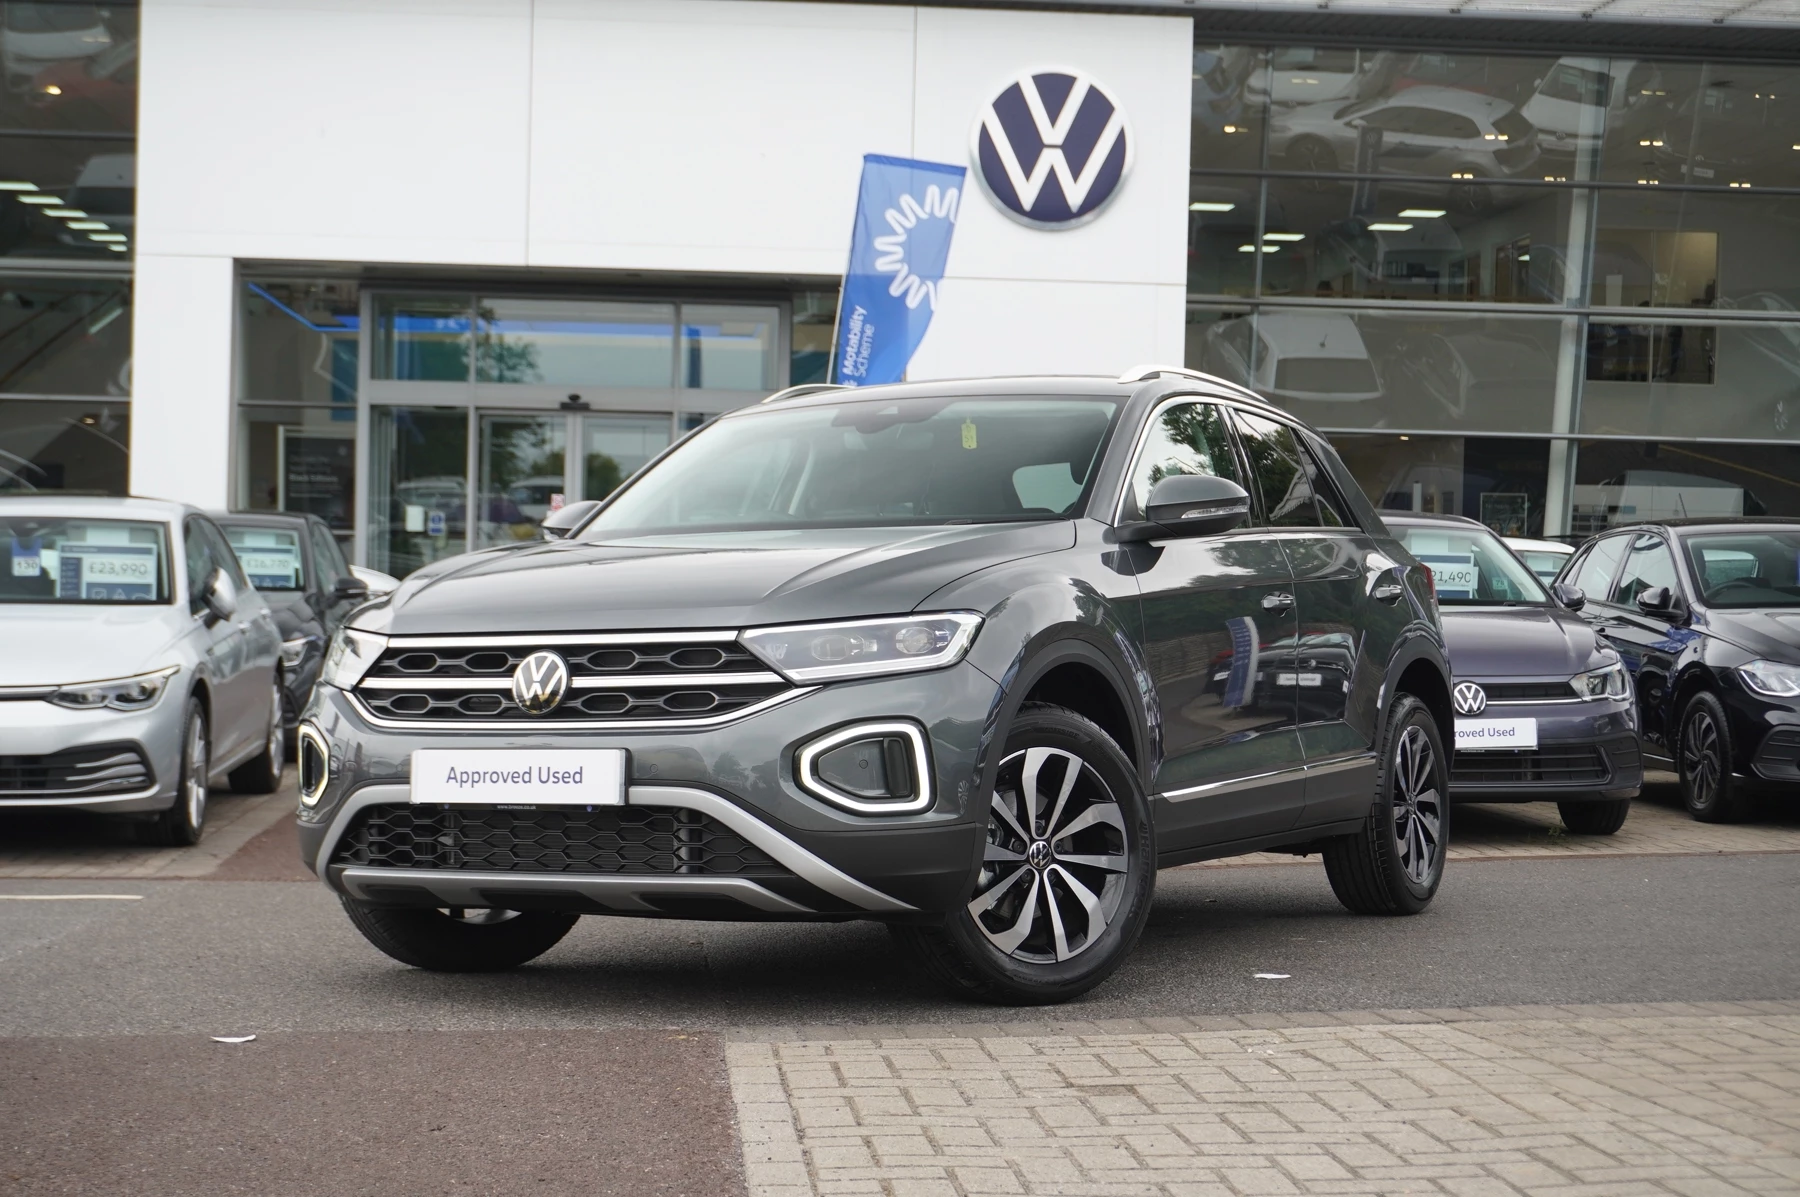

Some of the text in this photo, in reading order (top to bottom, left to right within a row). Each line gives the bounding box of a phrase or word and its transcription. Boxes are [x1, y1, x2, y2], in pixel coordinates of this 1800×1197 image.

[842, 304, 868, 376] Motability
[853, 323, 875, 378] Scheme
[89, 561, 148, 576] £23,990
[1431, 570, 1472, 584] 21,490
[1454, 727, 1516, 738] roved Used
[446, 766, 583, 788] Approved Used
